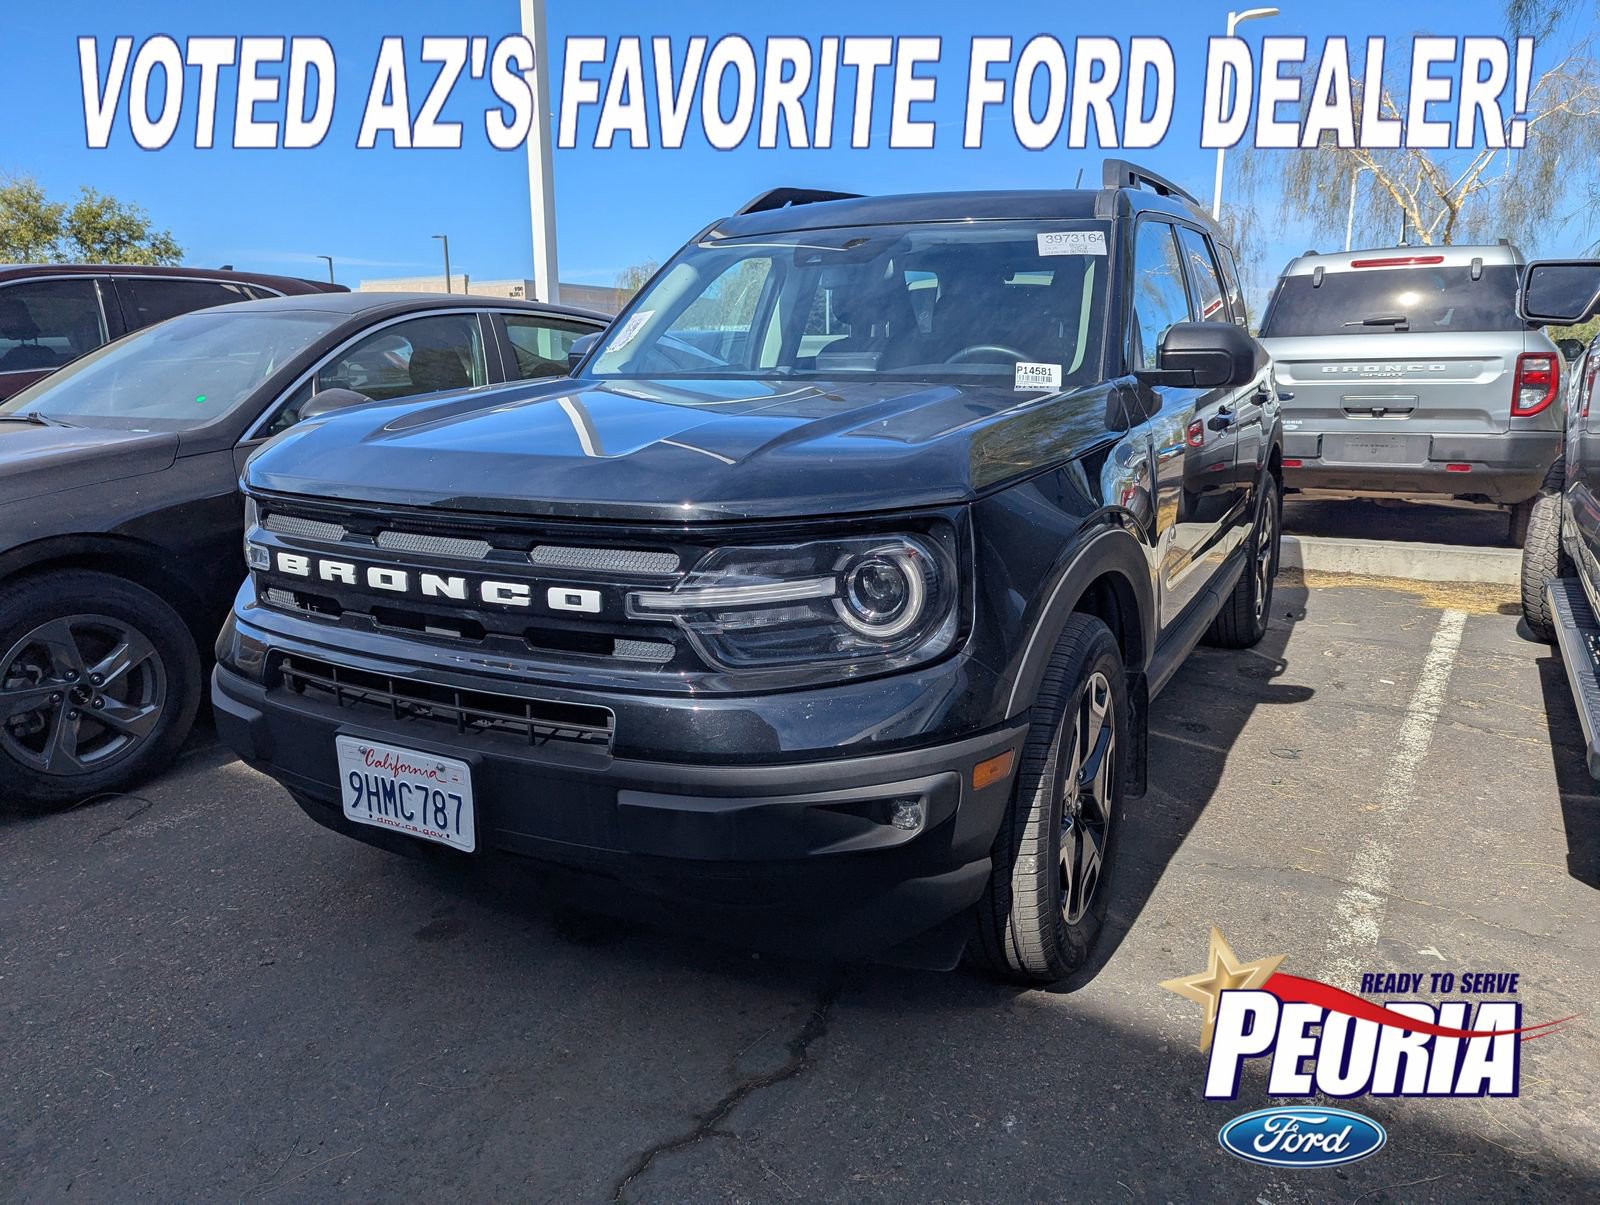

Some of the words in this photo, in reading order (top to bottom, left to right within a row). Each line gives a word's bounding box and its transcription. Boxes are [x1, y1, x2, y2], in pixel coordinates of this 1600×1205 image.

[1045, 233, 1105, 245] 3973164
[1016, 365, 1053, 377] P14581
[1321, 364, 1446, 374] BRONCO
[276, 552, 604, 614] BRONCO
[364, 748, 448, 784] California
[348, 770, 463, 835] 9HMC787
[376, 816, 444, 838] dmv.ca.gov
